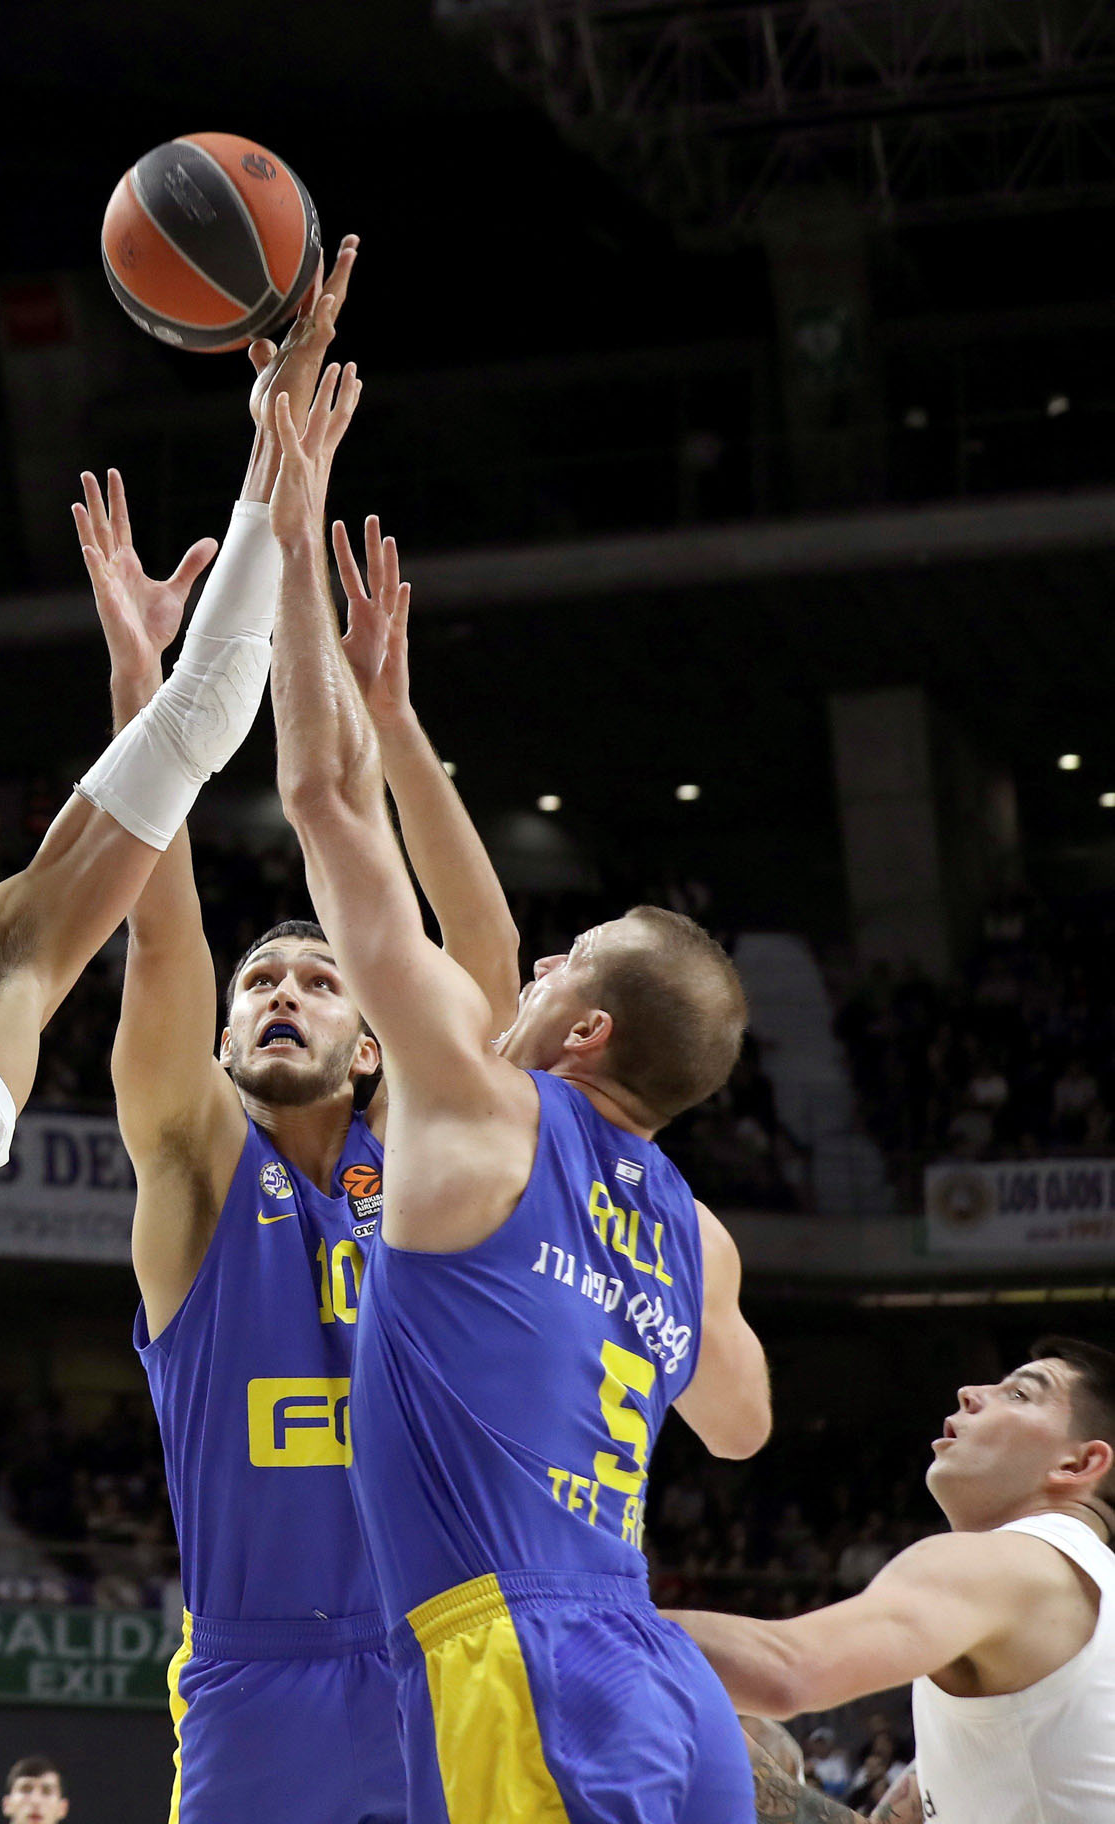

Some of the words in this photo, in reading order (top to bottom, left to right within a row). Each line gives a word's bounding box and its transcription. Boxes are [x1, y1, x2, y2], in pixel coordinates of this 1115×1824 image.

[316, 1237, 364, 1324] 10
[593, 1340, 656, 1495] 5
[28, 1661, 131, 1698] EXIT
